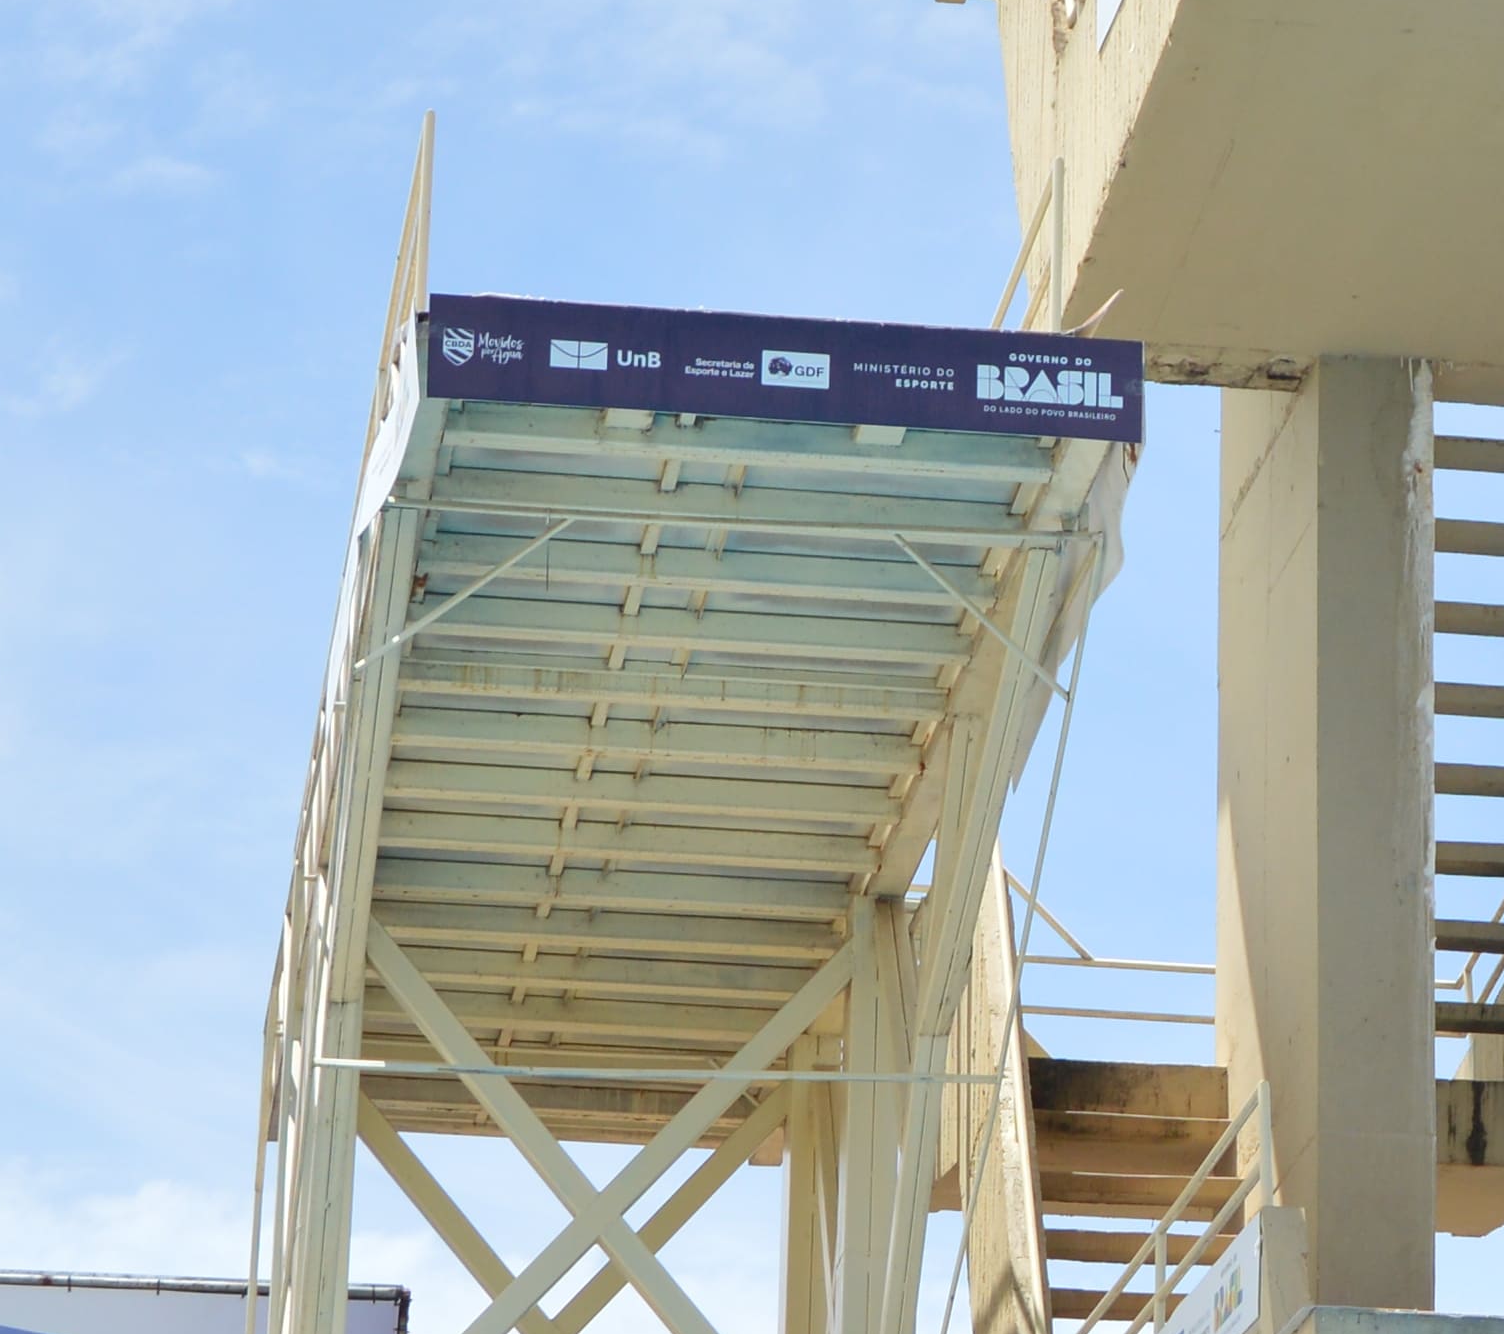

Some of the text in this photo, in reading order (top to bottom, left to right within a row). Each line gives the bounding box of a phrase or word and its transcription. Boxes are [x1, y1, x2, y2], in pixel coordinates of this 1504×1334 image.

[445, 339, 472, 348] CBDA
[478, 331, 525, 351] Movidos
[617, 350, 661, 368] UnB
[695, 357, 741, 370] Secretaria
[1009, 352, 1092, 367] GOVERNO DO
[684, 366, 720, 378] Esporte
[729, 368, 755, 379] Lazer
[794, 365, 825, 378] GDF
[853, 361, 955, 378] MINISTÉRIO DO
[895, 378, 955, 392] ESPORTE
[976, 364, 1124, 409] BRASIL
[983, 404, 1116, 422] DO LADO DO POVO BRASILEIRO
